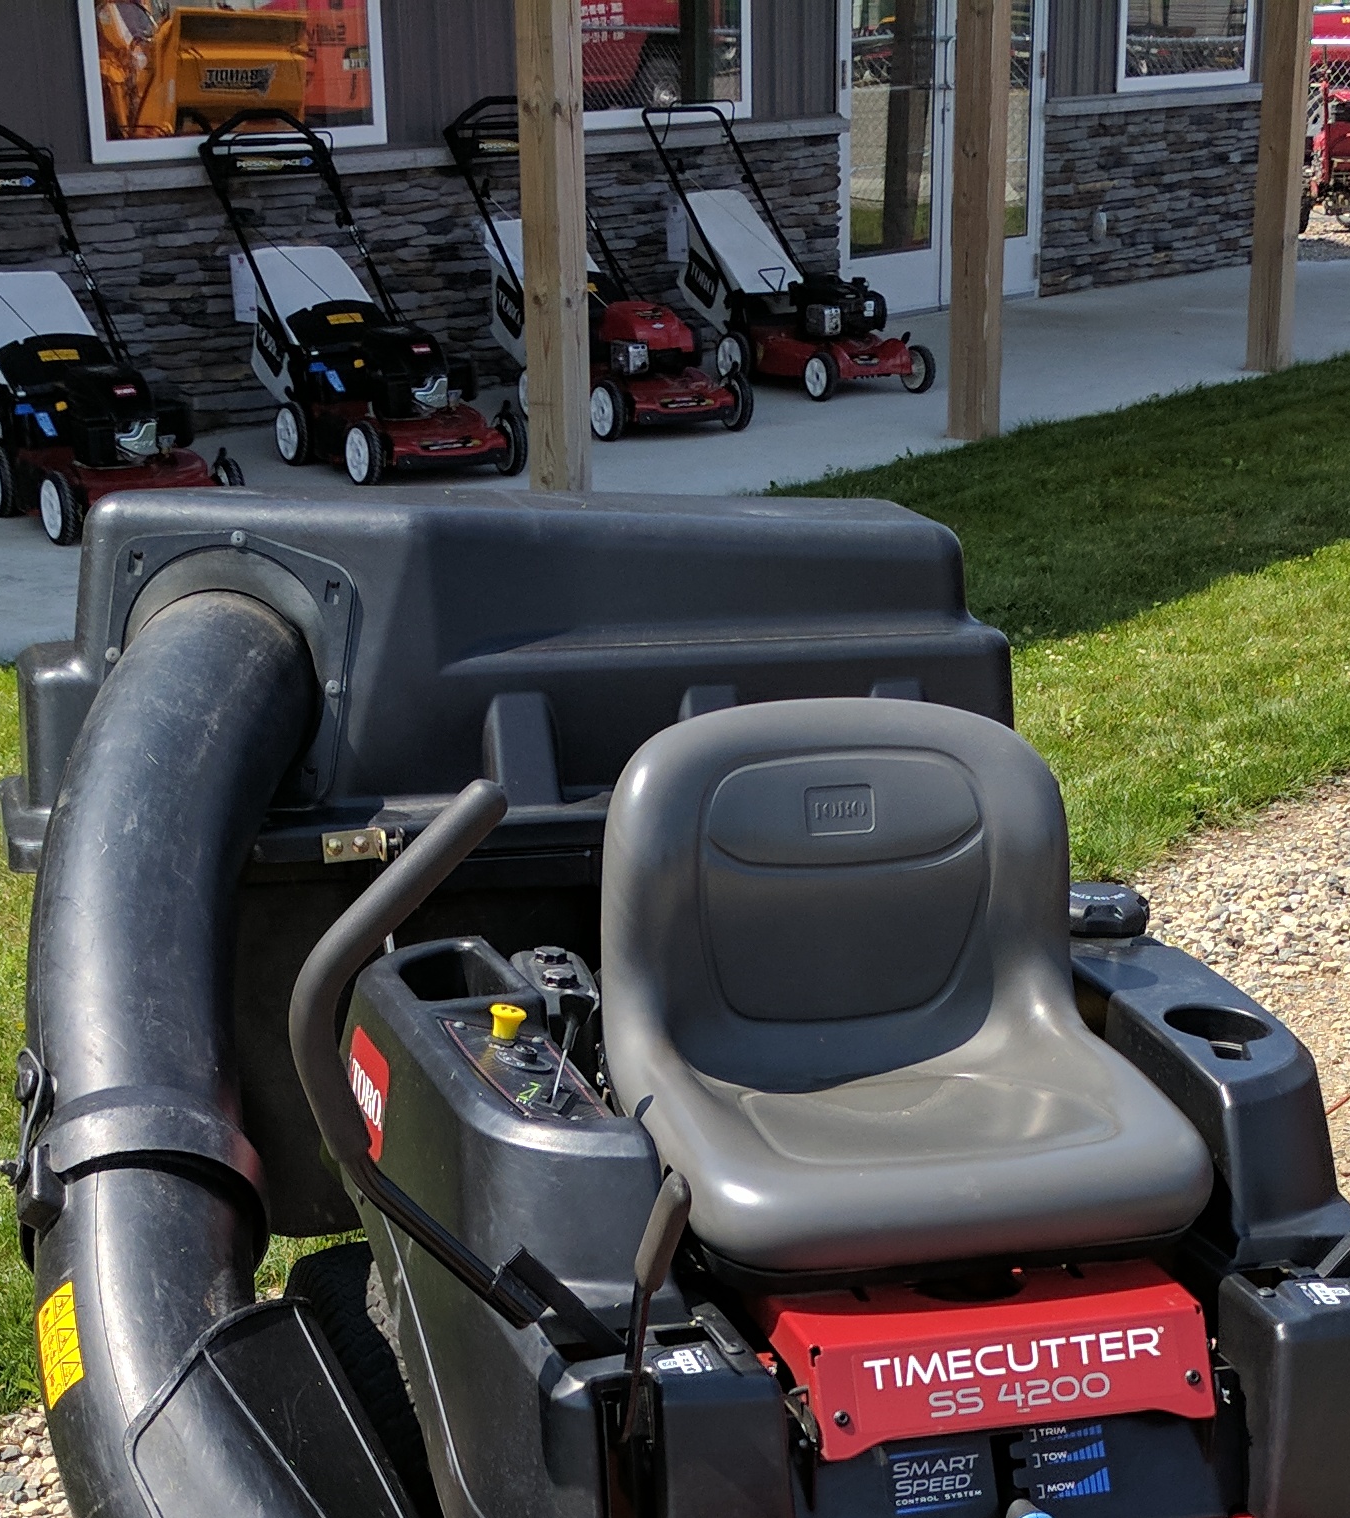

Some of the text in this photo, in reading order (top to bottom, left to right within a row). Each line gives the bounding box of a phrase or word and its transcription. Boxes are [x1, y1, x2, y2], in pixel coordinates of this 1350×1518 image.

[814, 800, 867, 819] TORO
[350, 1057, 383, 1128] TORO
[863, 1327, 1162, 1390] TIMECUTTER
[928, 1372, 1111, 1418] SS 4200
[1039, 1425, 1067, 1437] TRIM
[892, 1453, 979, 1479] SMART
[1042, 1450, 1068, 1462] TOW
[894, 1473, 972, 1497] SPEED
[1046, 1480, 1076, 1493] MOW
[895, 1489, 983, 1507] CONTROL SYSTEM
